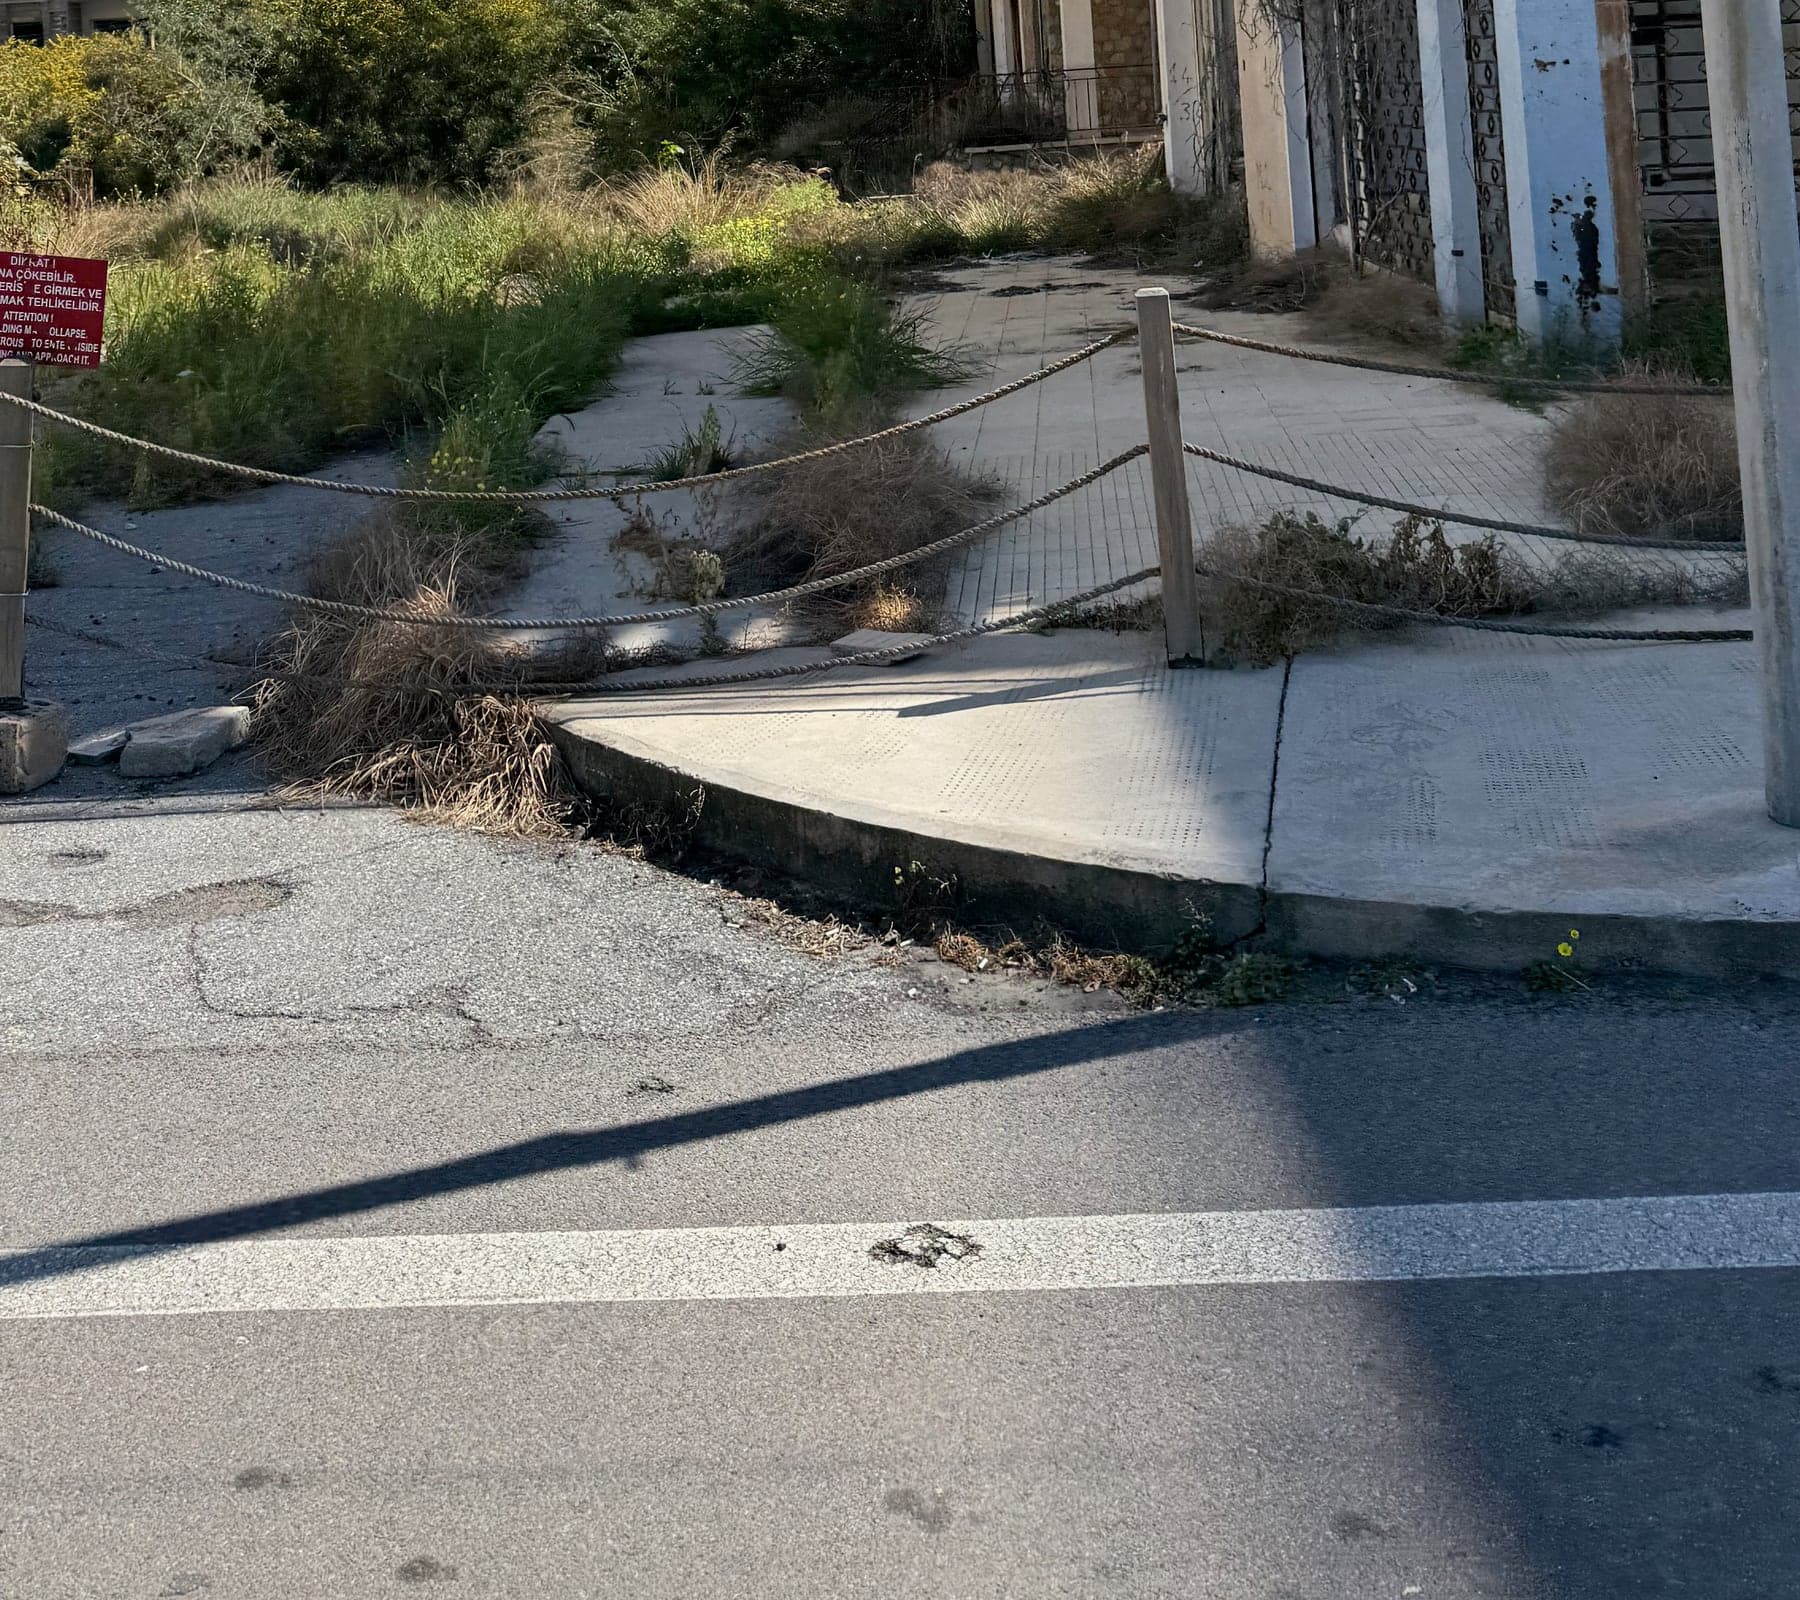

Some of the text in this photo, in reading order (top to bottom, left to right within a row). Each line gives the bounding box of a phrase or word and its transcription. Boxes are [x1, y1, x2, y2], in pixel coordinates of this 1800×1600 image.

[16, 267, 77, 283] ÇÖKEBİLİR.
[44, 283, 86, 298] GİRMEK
[88, 288, 103, 299] VE
[27, 296, 102, 312] TEHLİKELİDİR.
[3, 311, 49, 323] ATTENTION
[49, 326, 88, 339] OLLAPSE.
[32, 338, 43, 348] TO
[44, 339, 71, 350] ENTE
